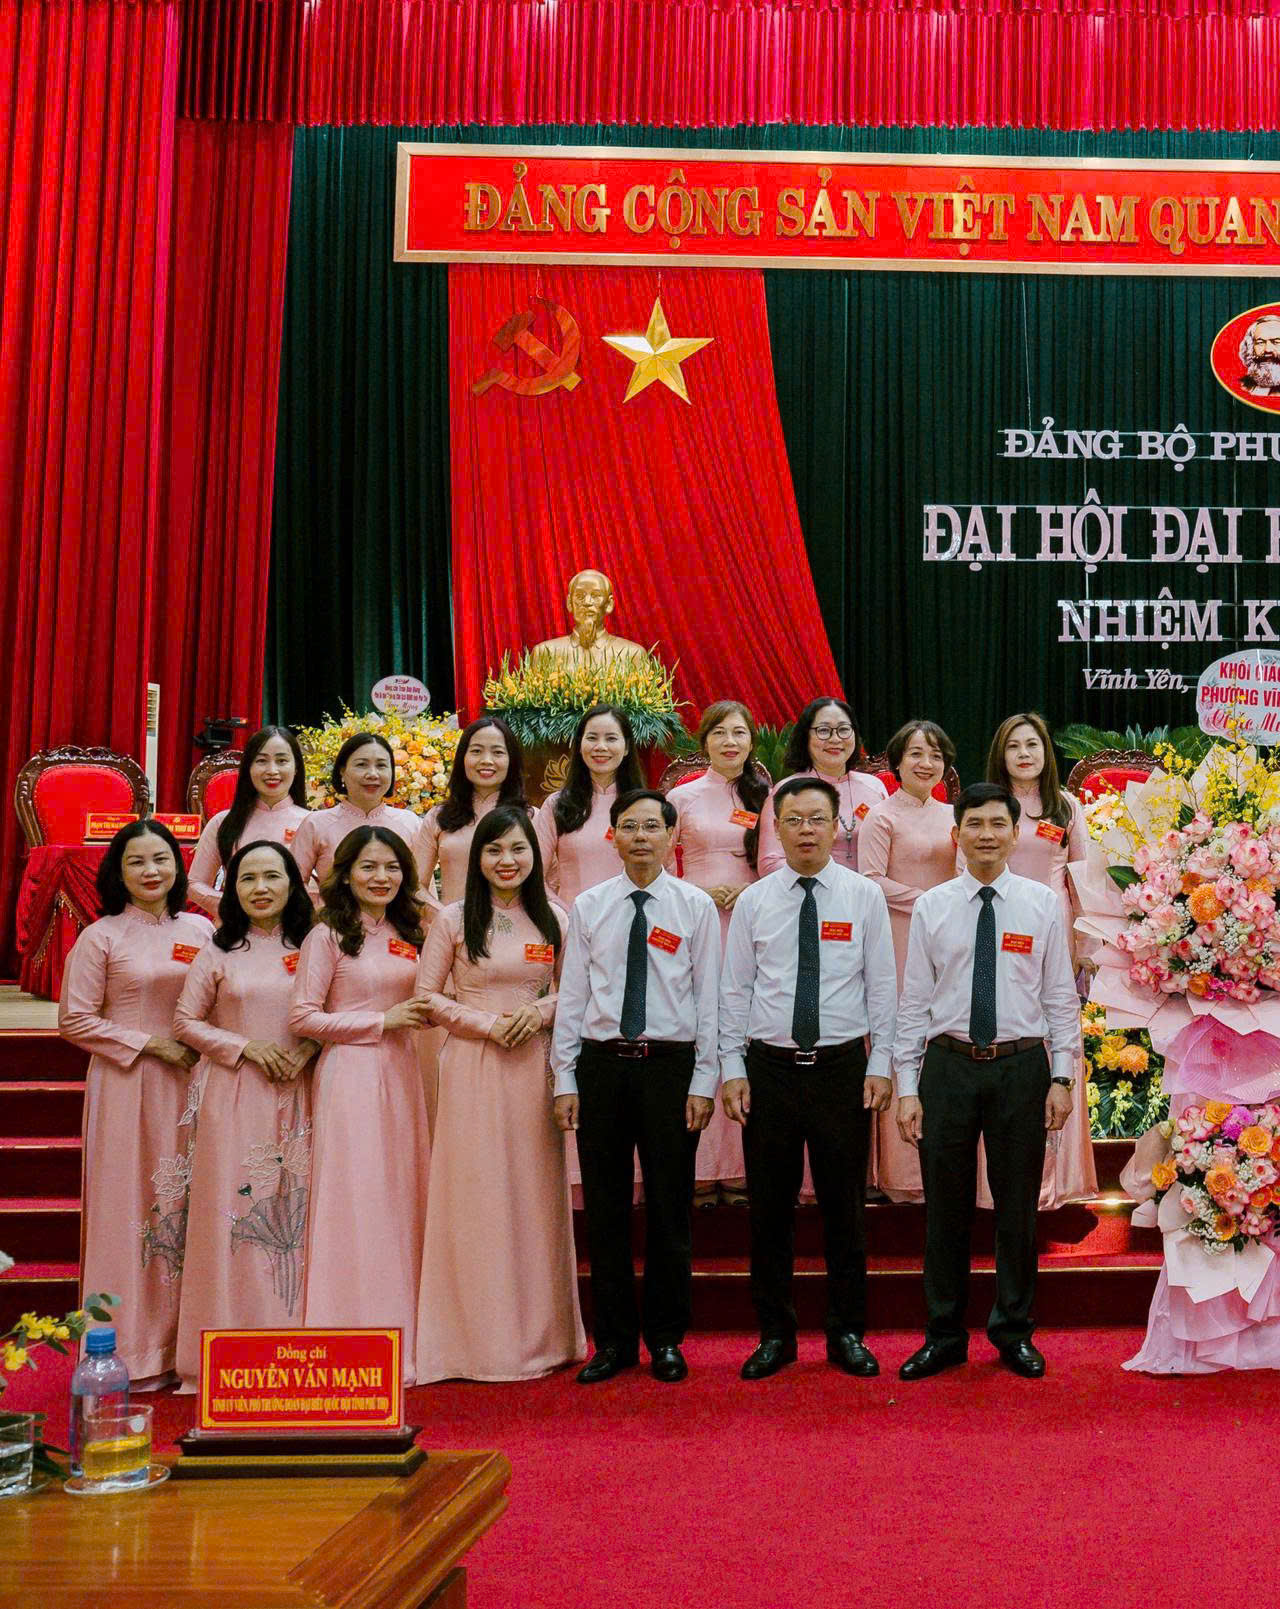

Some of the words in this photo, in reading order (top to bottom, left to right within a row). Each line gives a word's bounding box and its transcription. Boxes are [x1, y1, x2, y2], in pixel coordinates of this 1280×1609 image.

[463, 162, 612, 233] ĐẢNG
[622, 167, 763, 249] CỘNG
[776, 166, 881, 238] SẢN
[891, 175, 1016, 255] VIỆT
[1027, 194, 1140, 243] NAM
[1005, 416, 1124, 459] ĐẢNG
[1137, 424, 1196, 472] BỘ
[923, 505, 1016, 571] ĐẠI
[1036, 488, 1128, 573] HỘI
[1151, 507, 1244, 573] ĐẠI
[1057, 587, 1223, 651] NHIỆM
[1082, 668, 1138, 690] Vĩnh
[1144, 668, 1190, 693] Yên,
[1219, 657, 1251, 681] KHỐI
[276, 1344, 308, 1362] Đồng
[309, 1345, 328, 1360] chí
[219, 1363, 290, 1390] NGUYỄN
[293, 1363, 328, 1388] VĂN
[331, 1367, 383, 1393] MẠNH
